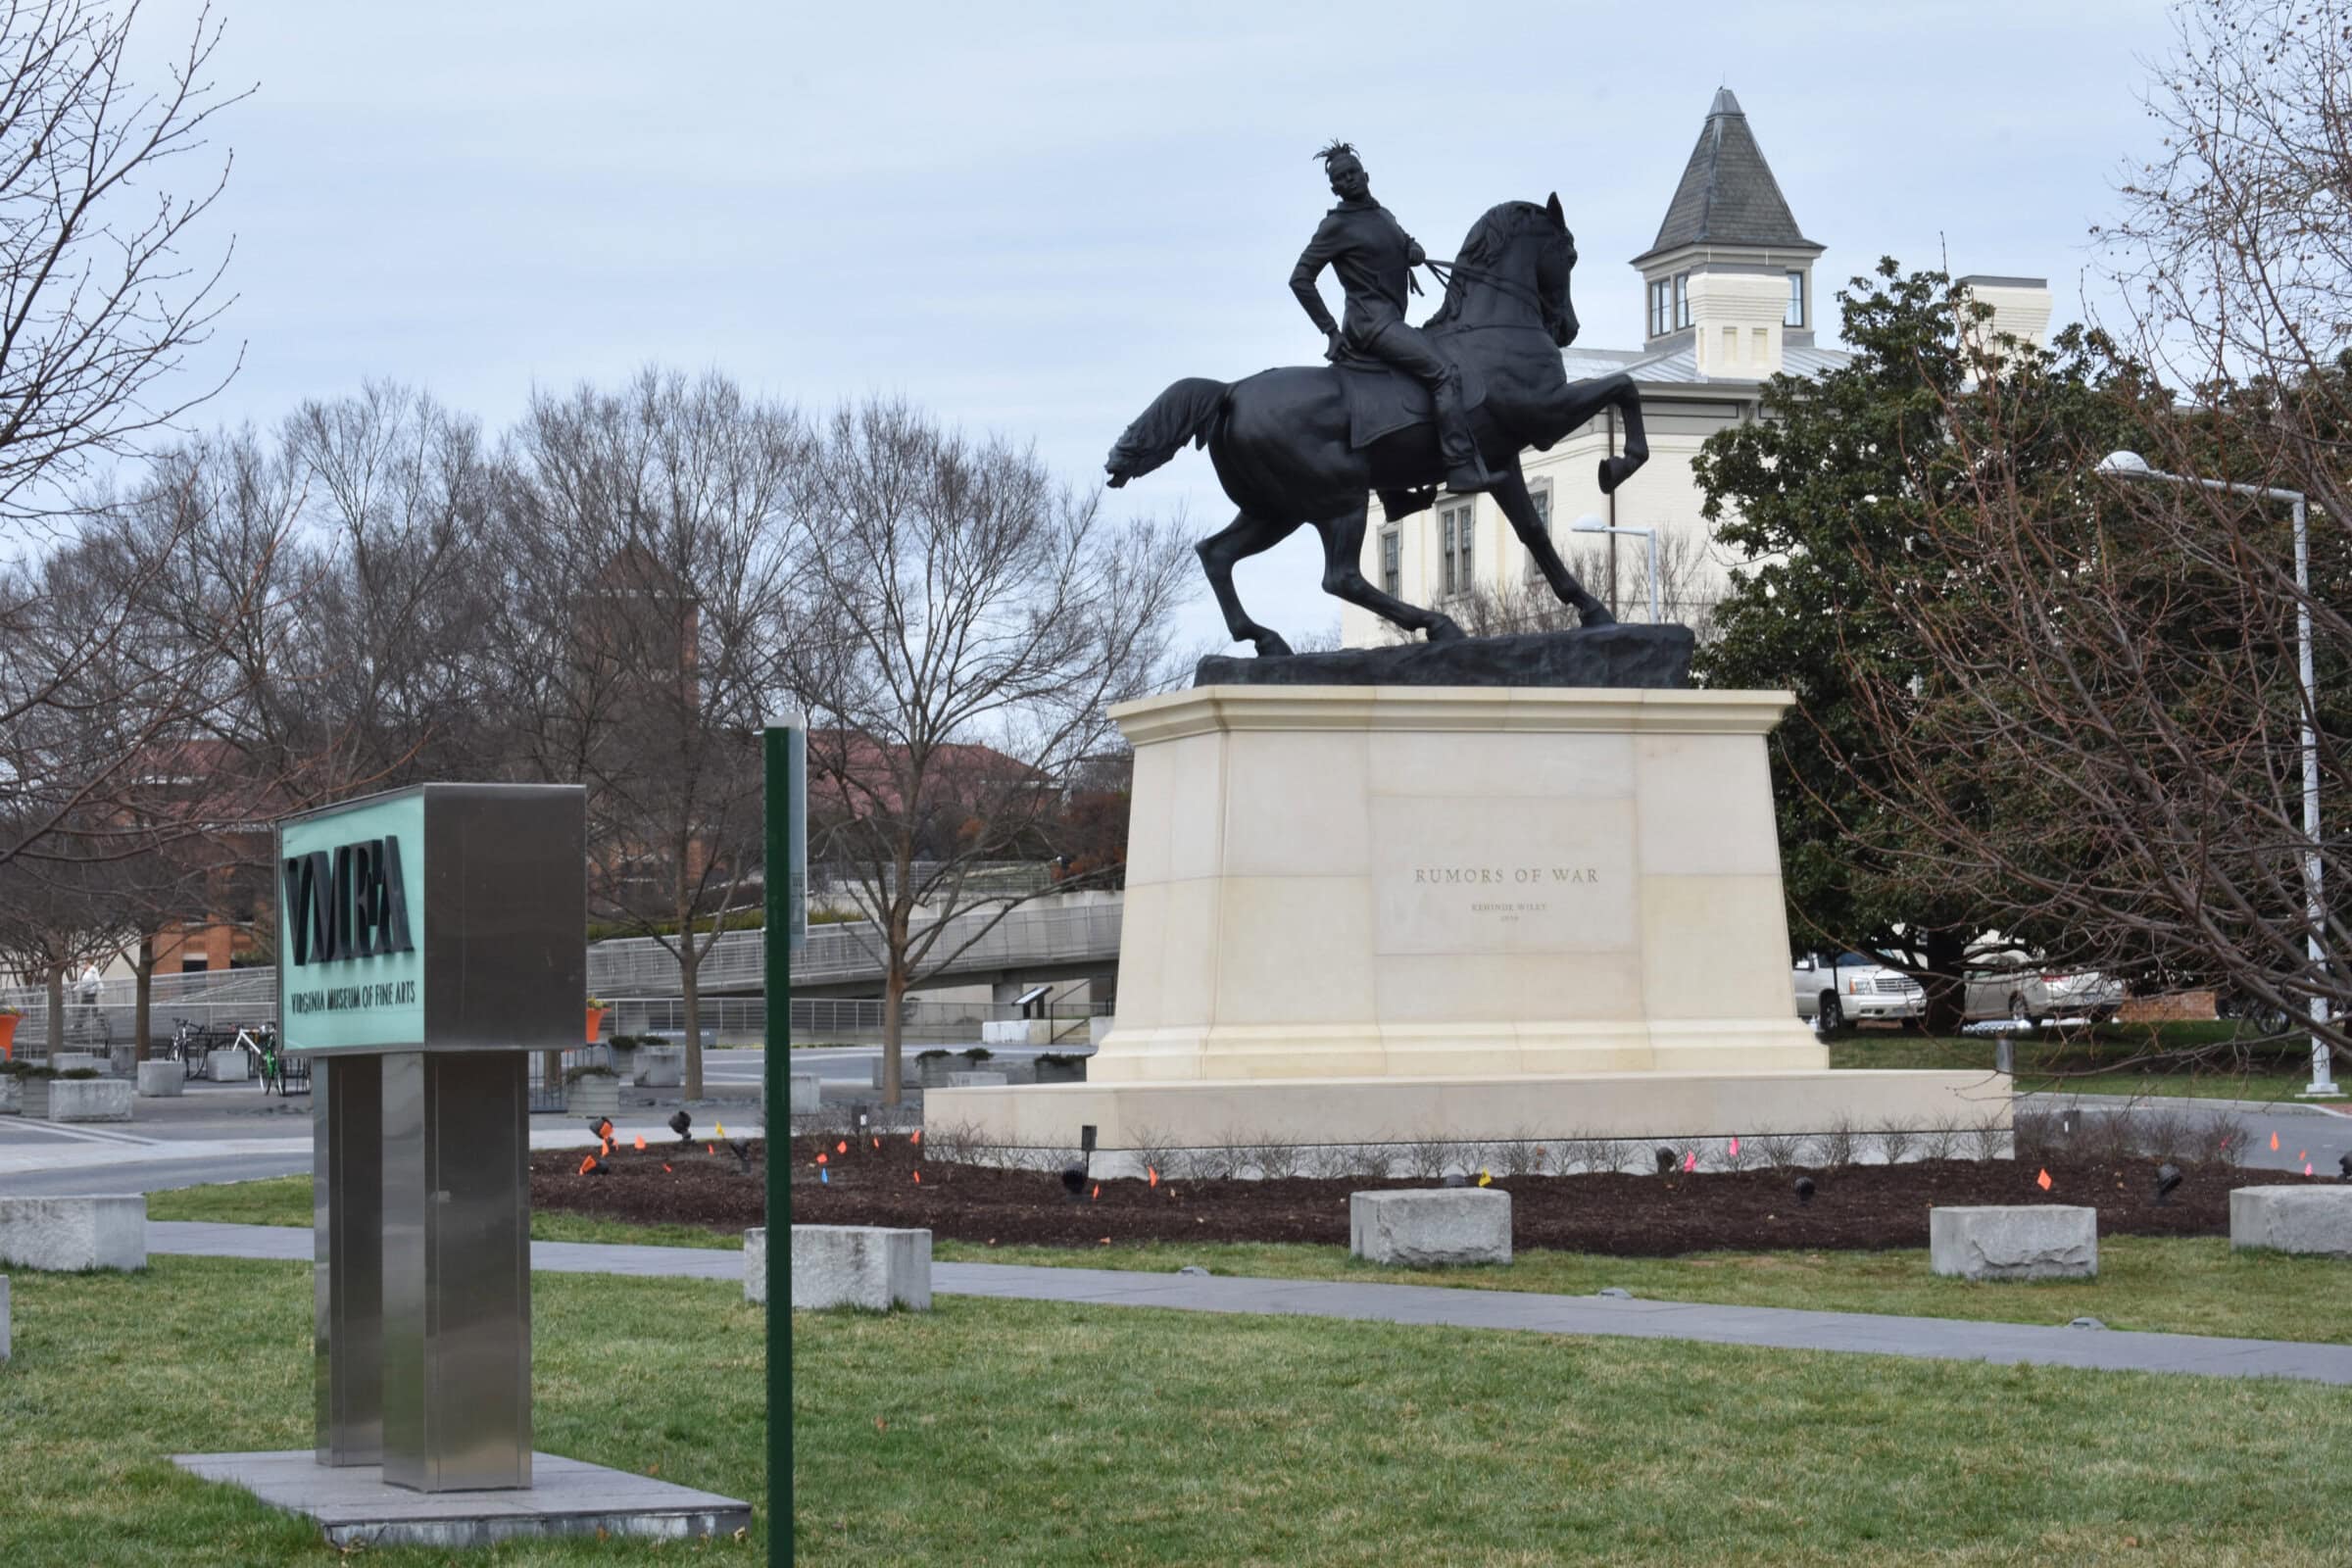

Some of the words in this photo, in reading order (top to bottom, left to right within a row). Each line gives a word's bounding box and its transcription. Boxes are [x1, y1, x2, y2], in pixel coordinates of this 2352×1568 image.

[1416, 868, 1504, 883] RUMORS
[1514, 868, 1543, 883] OF
[1551, 868, 1599, 883] WAR
[282, 835, 415, 966] VMFA
[291, 990, 324, 1015] VIRGINIA
[327, 985, 360, 1010] MUSEUM
[362, 986, 372, 1008] OF
[374, 983, 393, 1005] FINE
[395, 980, 416, 1004] ARTS
